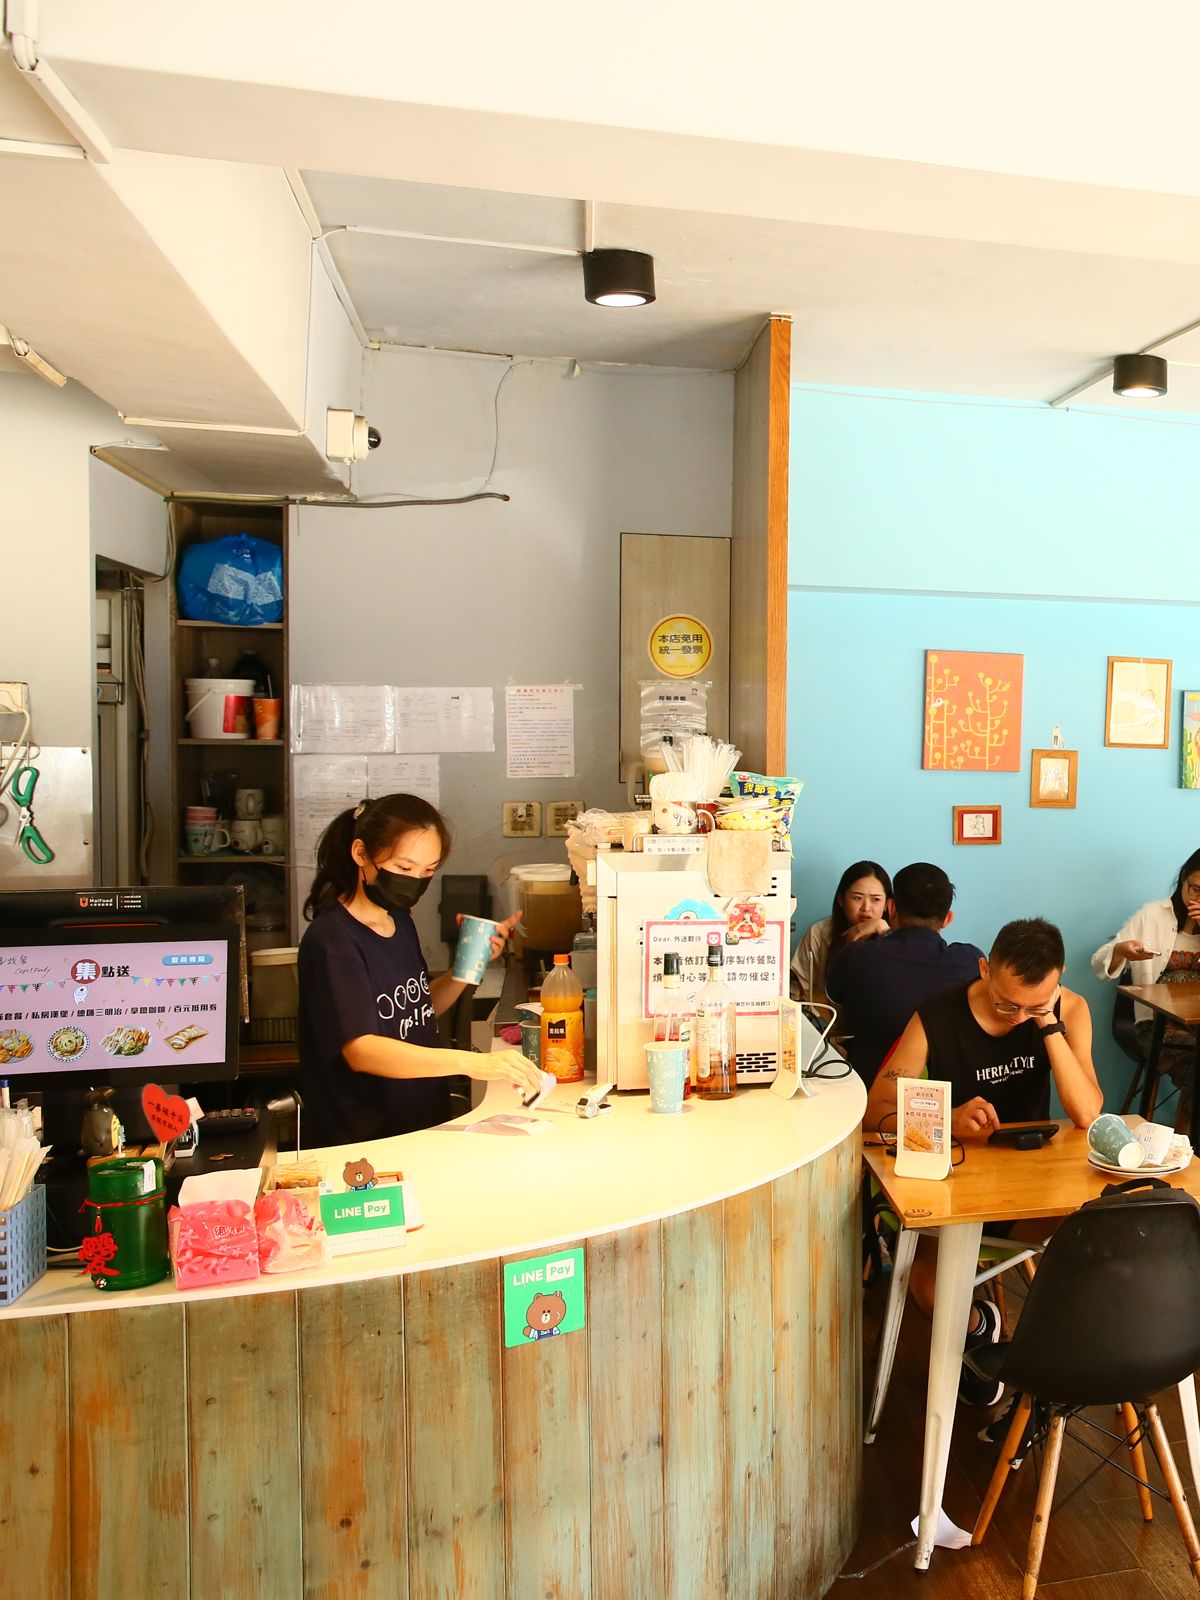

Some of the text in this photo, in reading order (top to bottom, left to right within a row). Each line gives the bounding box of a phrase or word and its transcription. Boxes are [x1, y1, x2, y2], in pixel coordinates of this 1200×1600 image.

[658, 634, 703, 643] 本店免用
[658, 645, 703, 655] 統一發票
[334, 1203, 387, 1219] LINE Pay
[513, 1264, 571, 1286] LINE Pay
